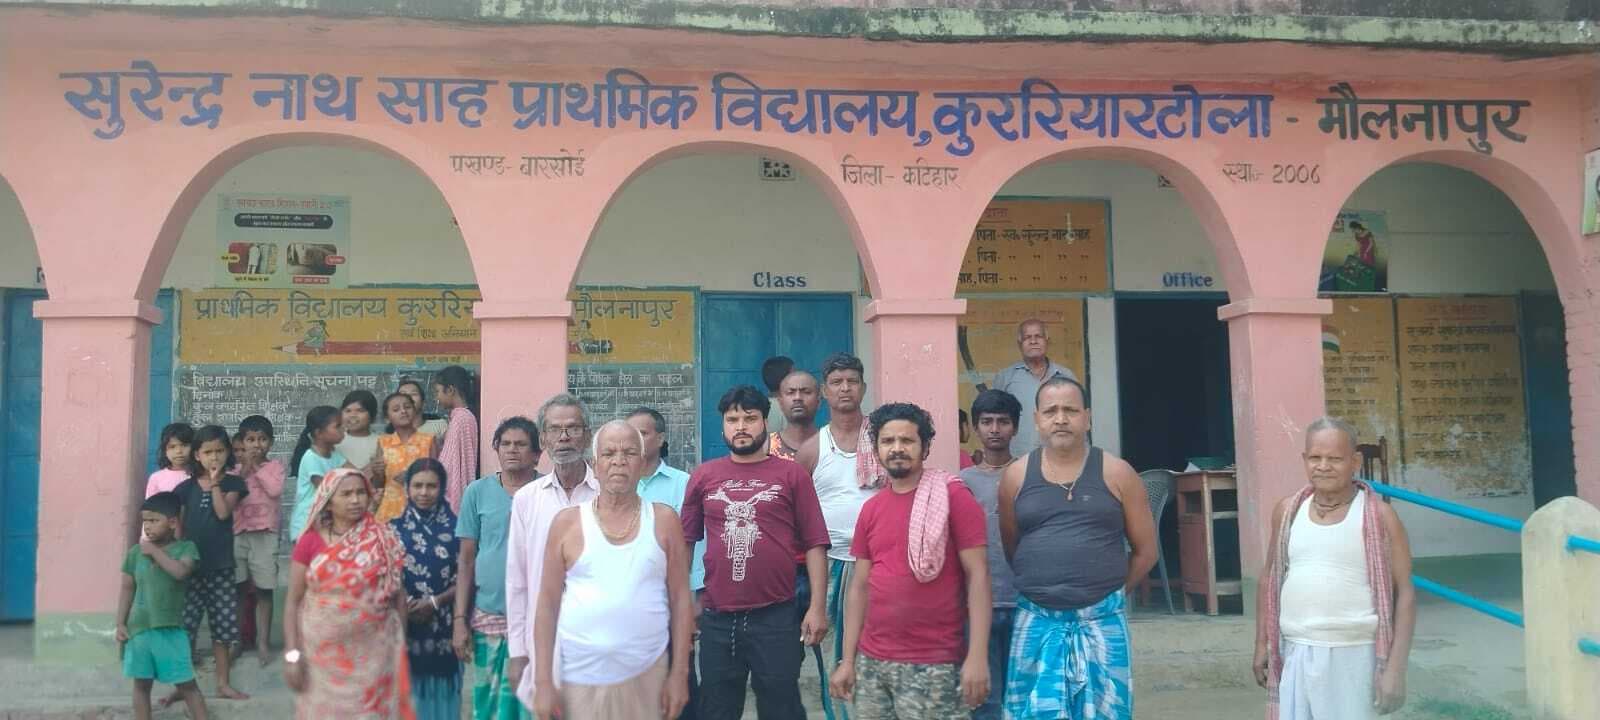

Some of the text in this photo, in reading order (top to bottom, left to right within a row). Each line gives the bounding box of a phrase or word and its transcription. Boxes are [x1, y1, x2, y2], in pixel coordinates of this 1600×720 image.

[59, 60, 232, 140] सुरेन्द्र
[249, 73, 363, 121] नाथ
[377, 77, 499, 128] साह
[508, 67, 699, 130] प्राथमिक
[1316, 82, 1531, 155] मौलनापुर
[1272, 164, 1320, 184] 2006
[753, 271, 807, 288] Class
[1162, 272, 1213, 287] Office
[194, 290, 280, 320] प्राथमिक
[288, 290, 386, 320] विद्यालय
